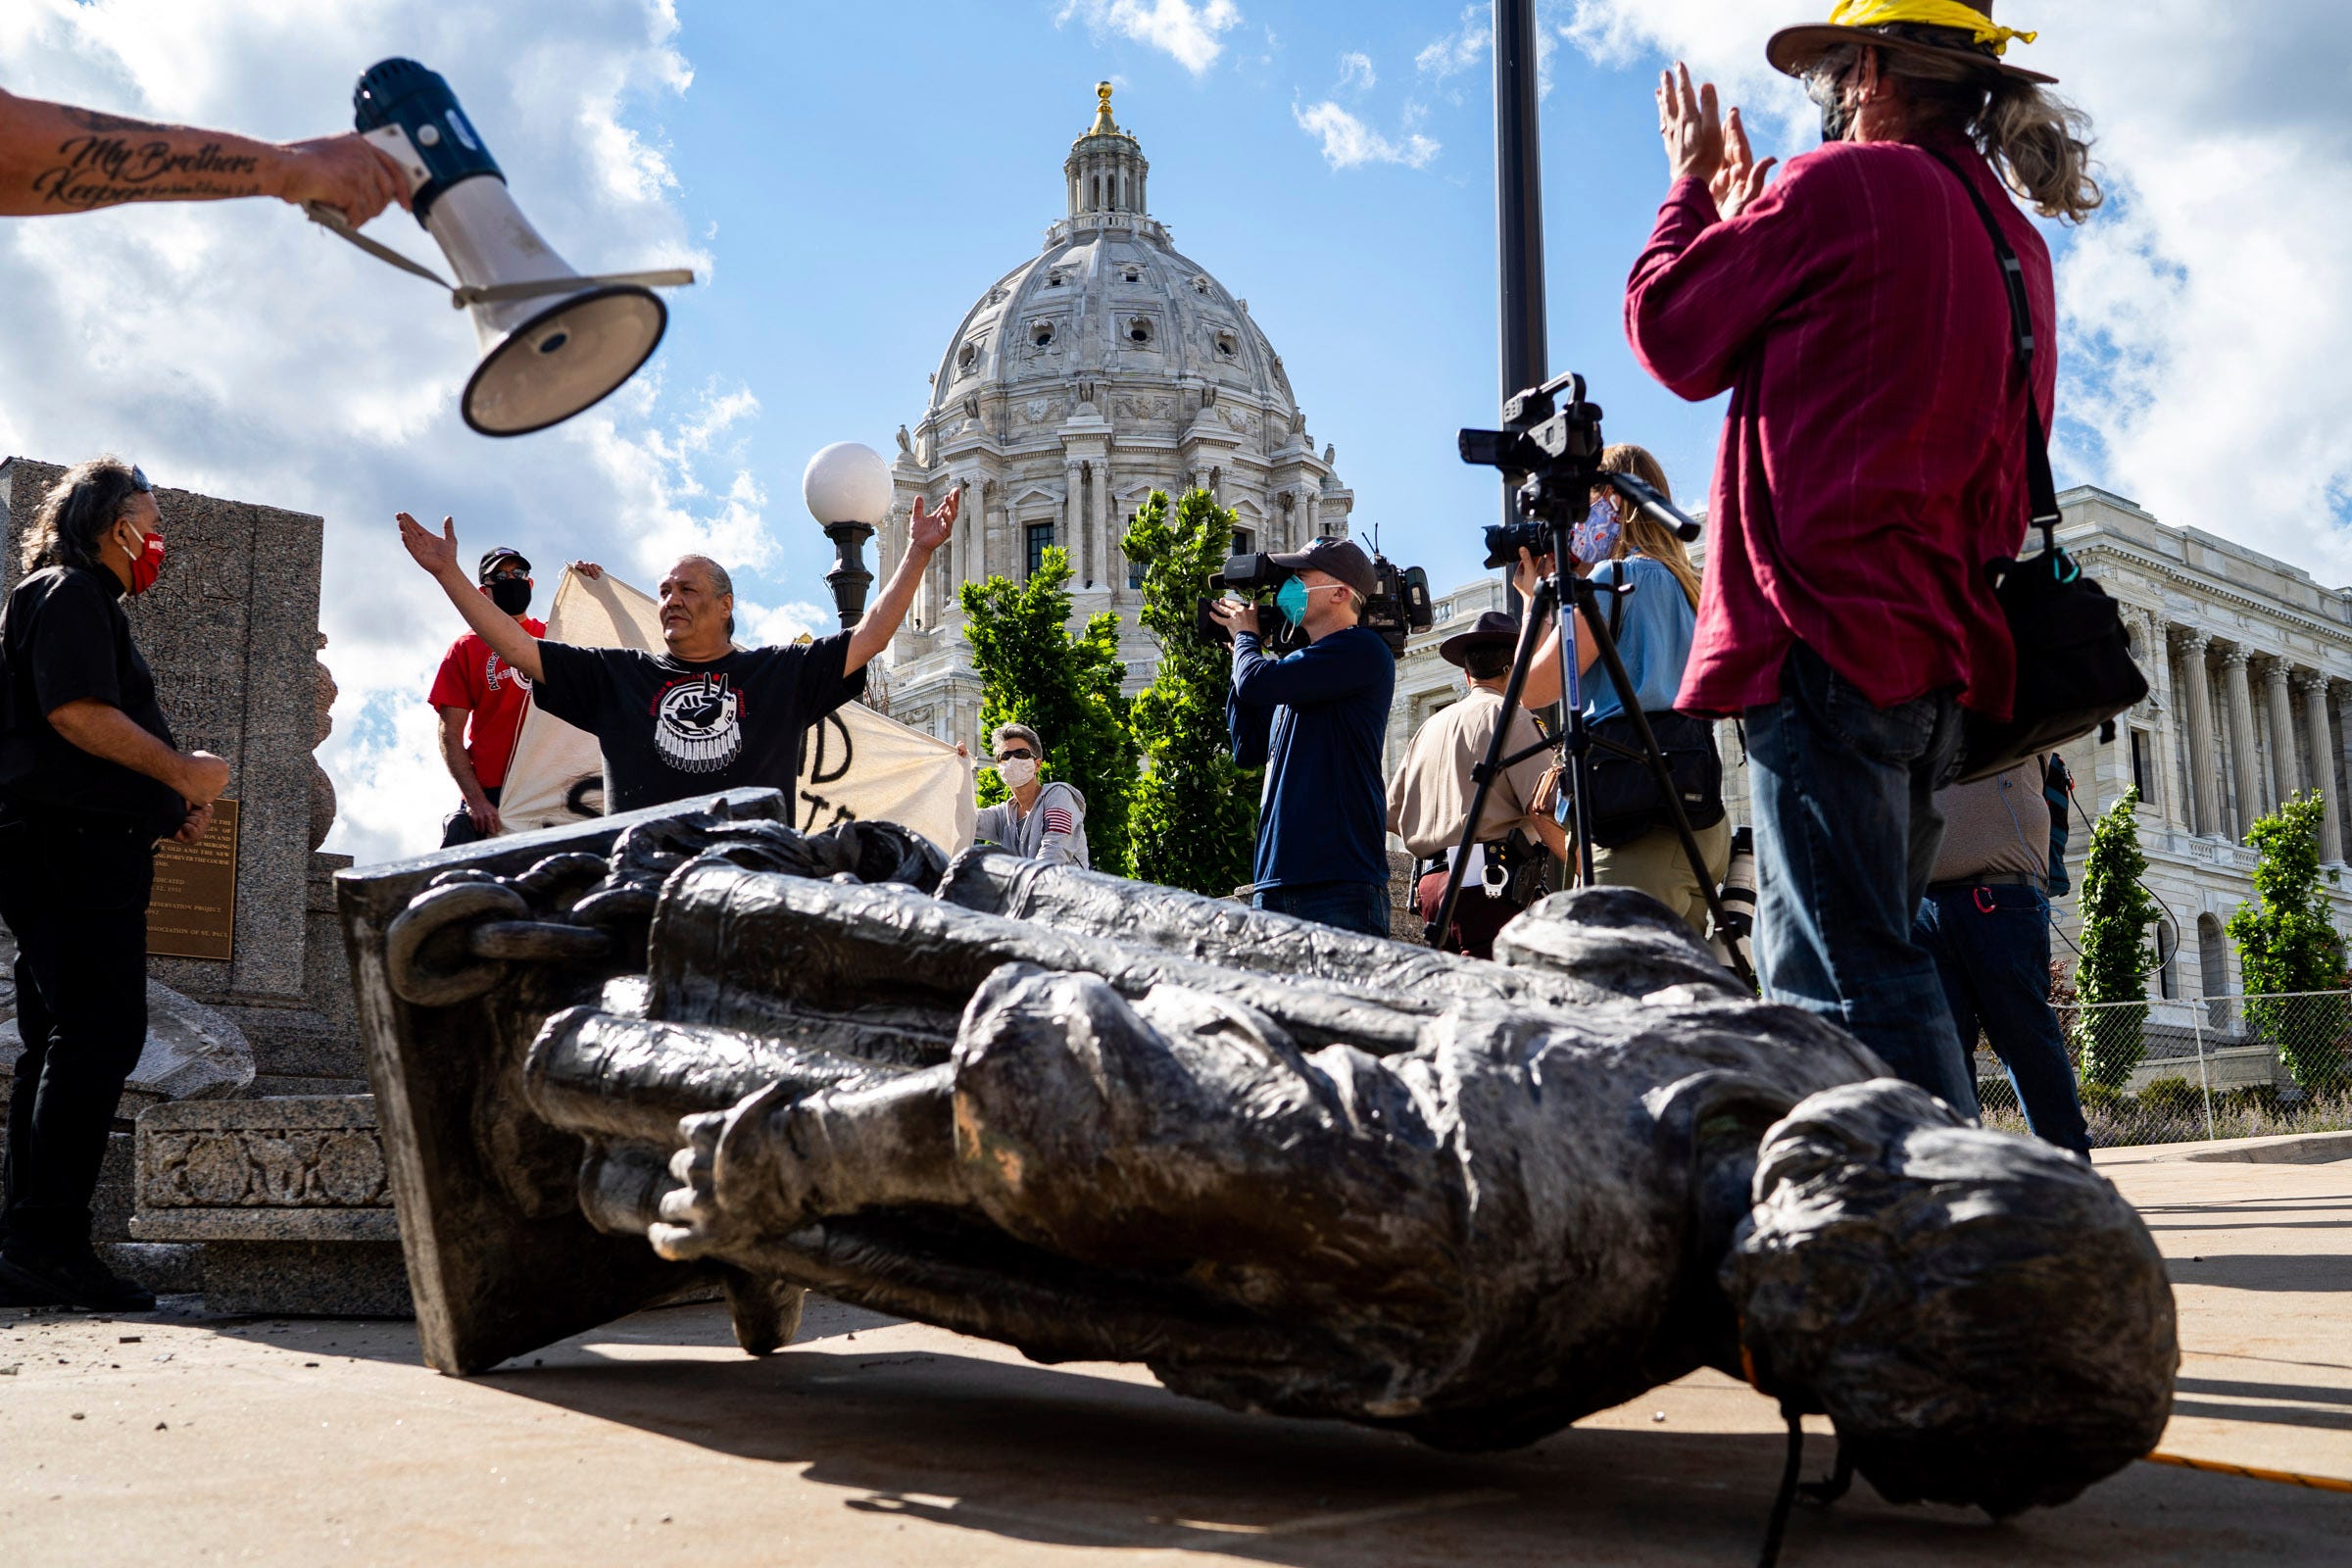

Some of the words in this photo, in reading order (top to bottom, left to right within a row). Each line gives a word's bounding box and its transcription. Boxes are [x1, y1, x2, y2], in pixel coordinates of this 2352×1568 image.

[59, 135, 134, 180] My
[123, 141, 259, 183] Brothers
[32, 166, 146, 208] Keeper
[486, 652, 501, 691] AMERICA
